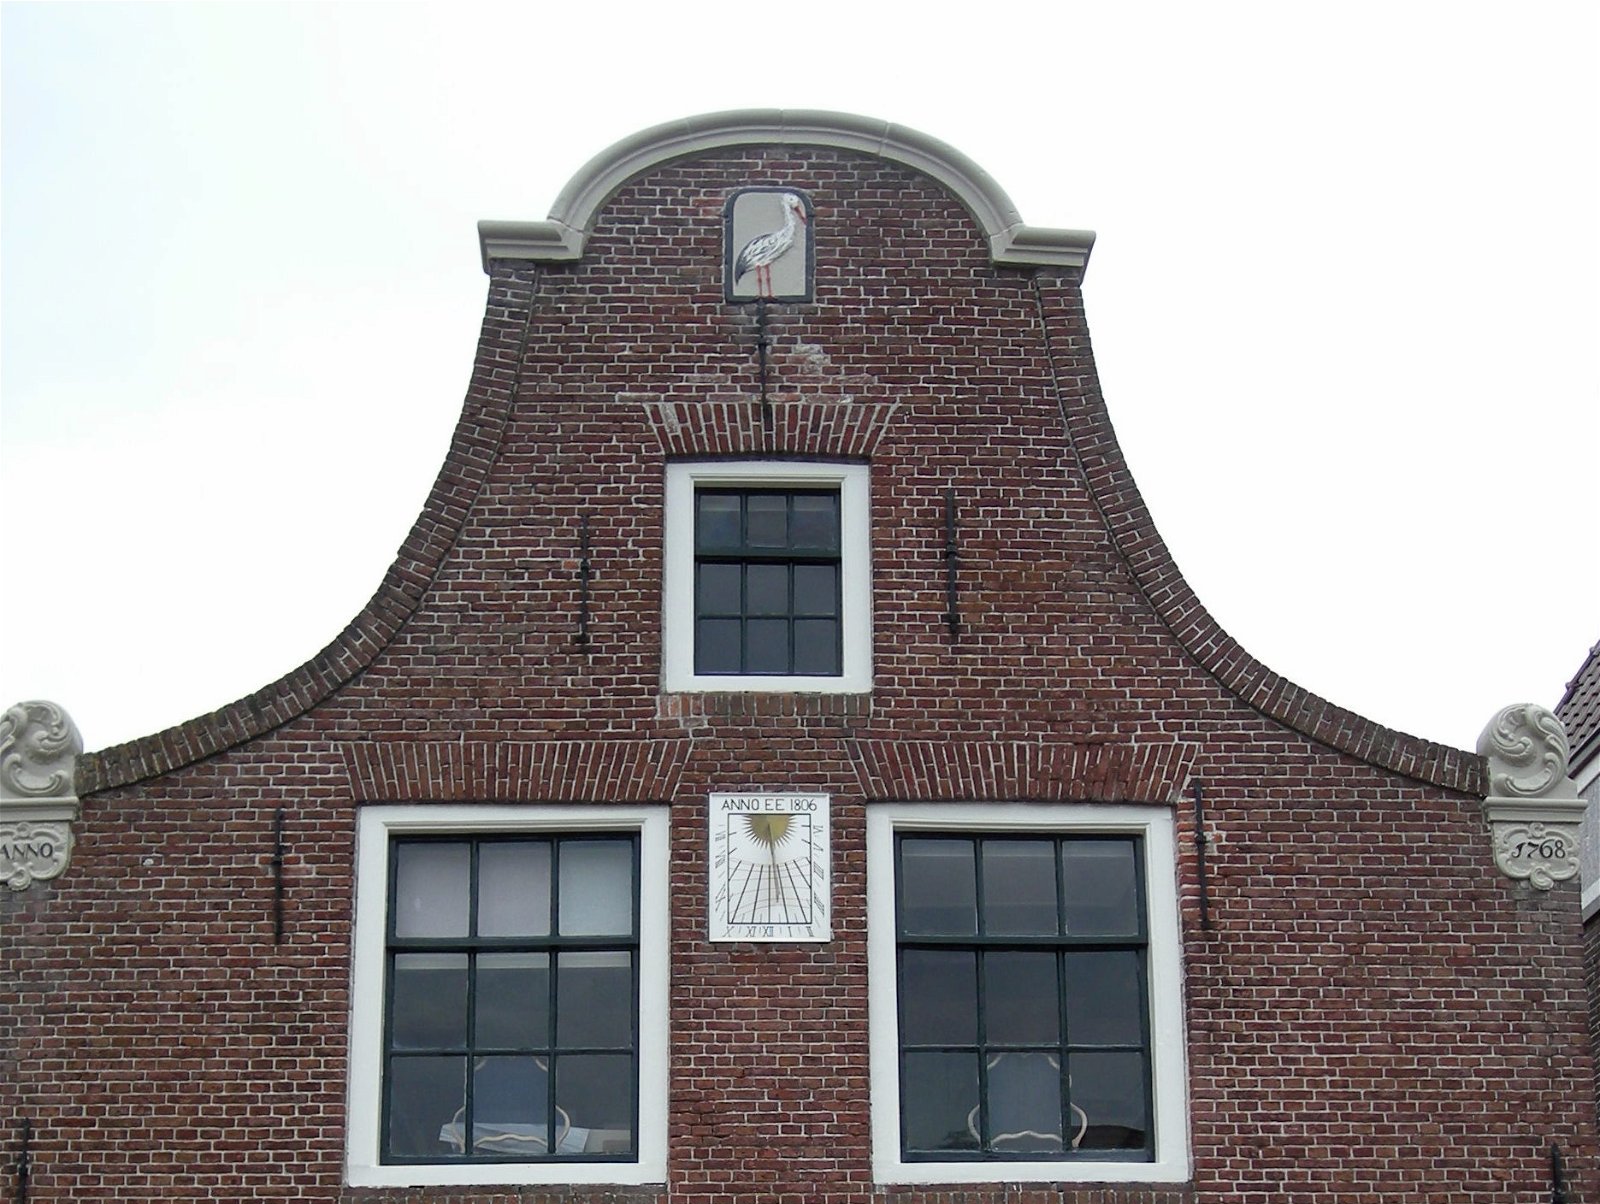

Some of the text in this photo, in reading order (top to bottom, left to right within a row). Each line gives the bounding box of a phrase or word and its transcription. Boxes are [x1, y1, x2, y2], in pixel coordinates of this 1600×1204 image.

[721, 798, 818, 811] ANNO EE 1806
[0, 842, 54, 860] ANNO
[1511, 839, 1566, 860] 1768
